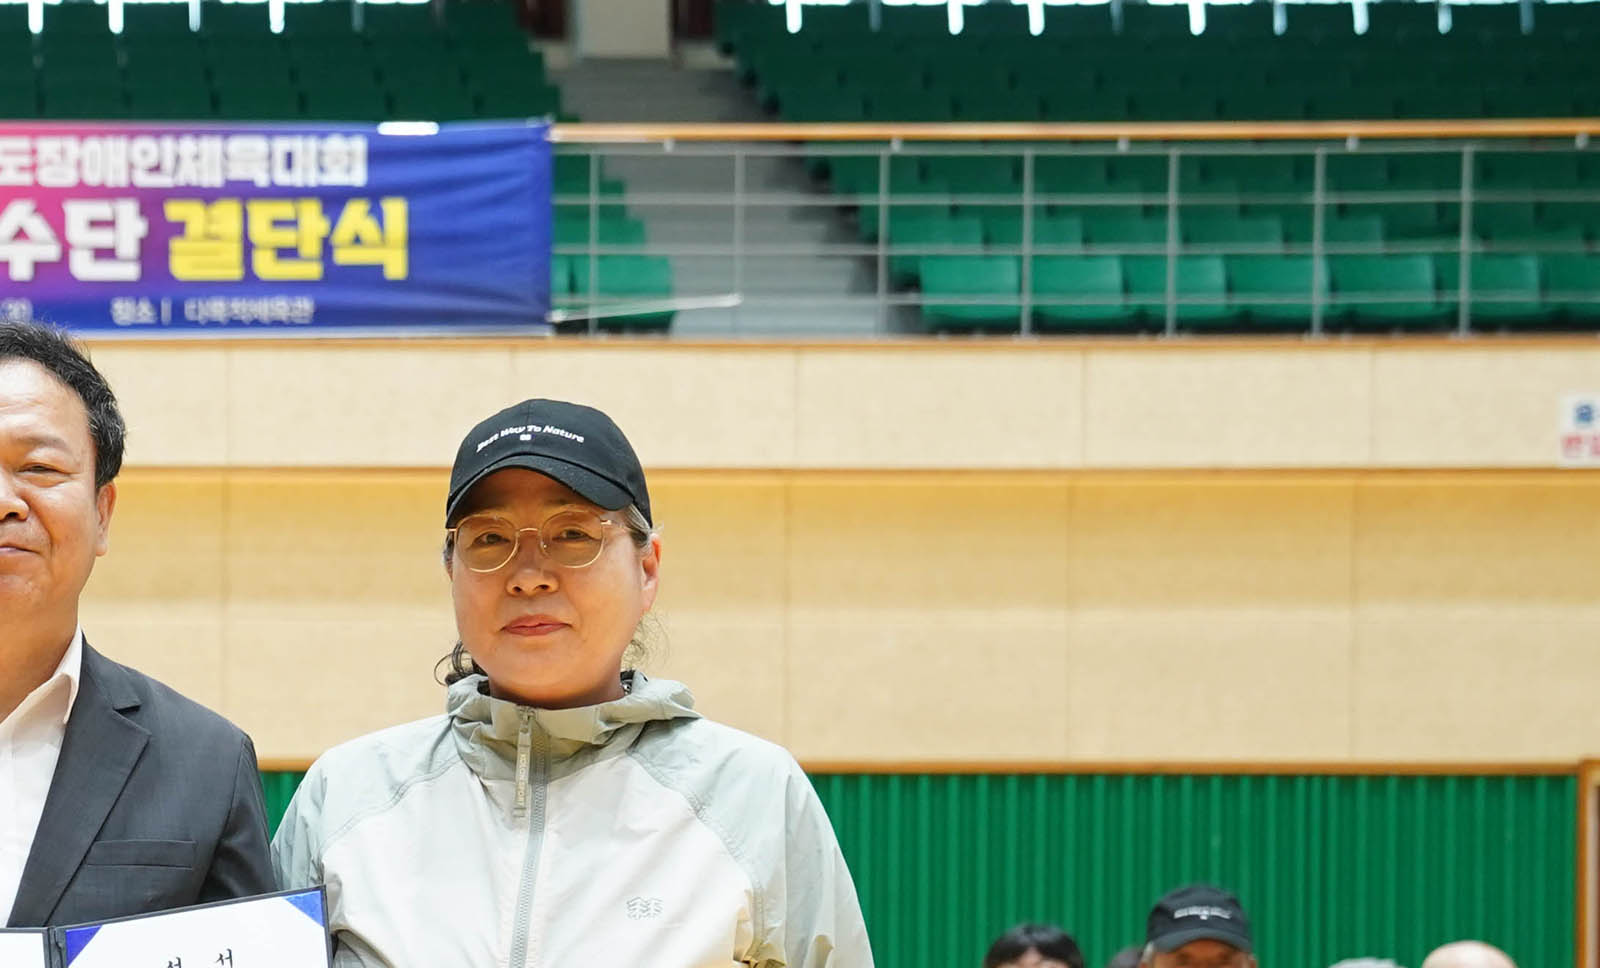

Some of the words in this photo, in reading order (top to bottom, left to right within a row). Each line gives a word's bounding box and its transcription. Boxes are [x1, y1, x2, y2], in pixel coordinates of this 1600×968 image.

[164, 198, 409, 282] 결단식
[526, 424, 542, 433] To
[542, 425, 585, 443] Nature
